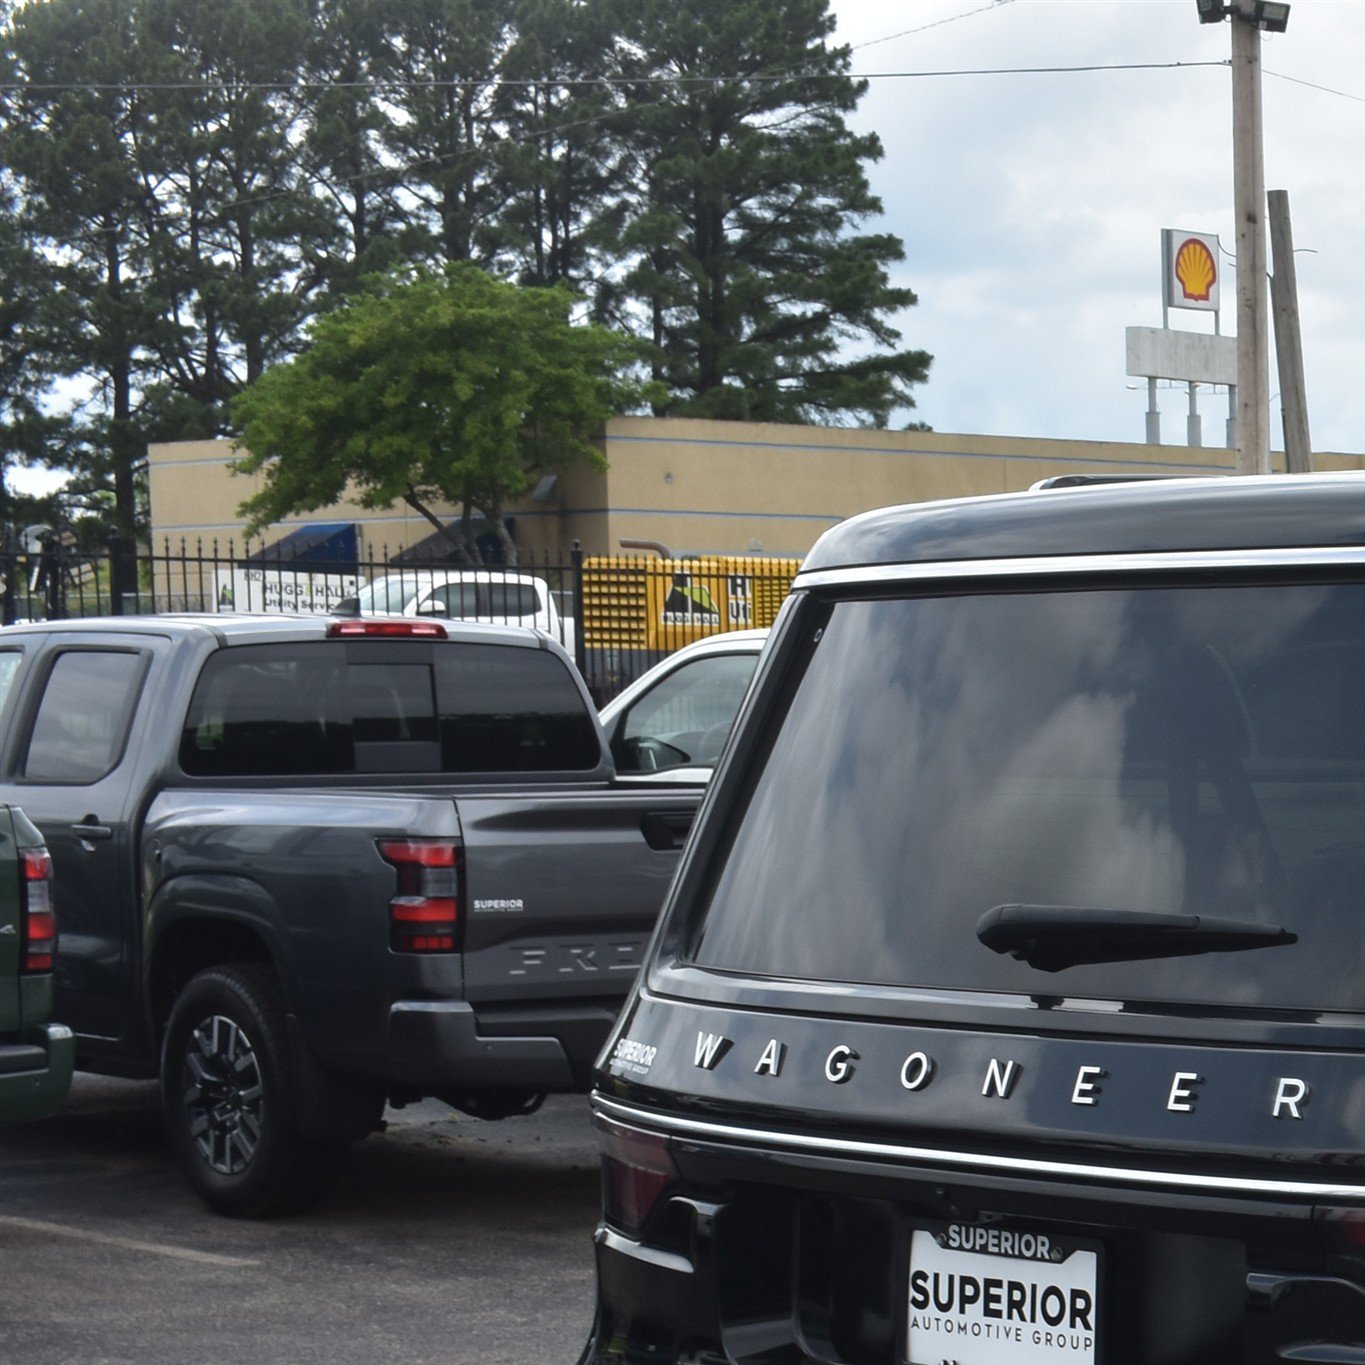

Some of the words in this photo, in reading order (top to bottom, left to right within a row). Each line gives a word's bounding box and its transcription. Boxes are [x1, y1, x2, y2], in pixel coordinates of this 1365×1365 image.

[473, 899, 524, 909] SUPERIOR
[696, 1029, 1308, 1119] WAGONEER
[948, 1224, 1051, 1260] SUPERIOR
[910, 1269, 1094, 1332] SUPERIOR
[910, 1314, 1023, 1343] AUTOMOTIVE
[1032, 1330, 1093, 1352] GROUP
